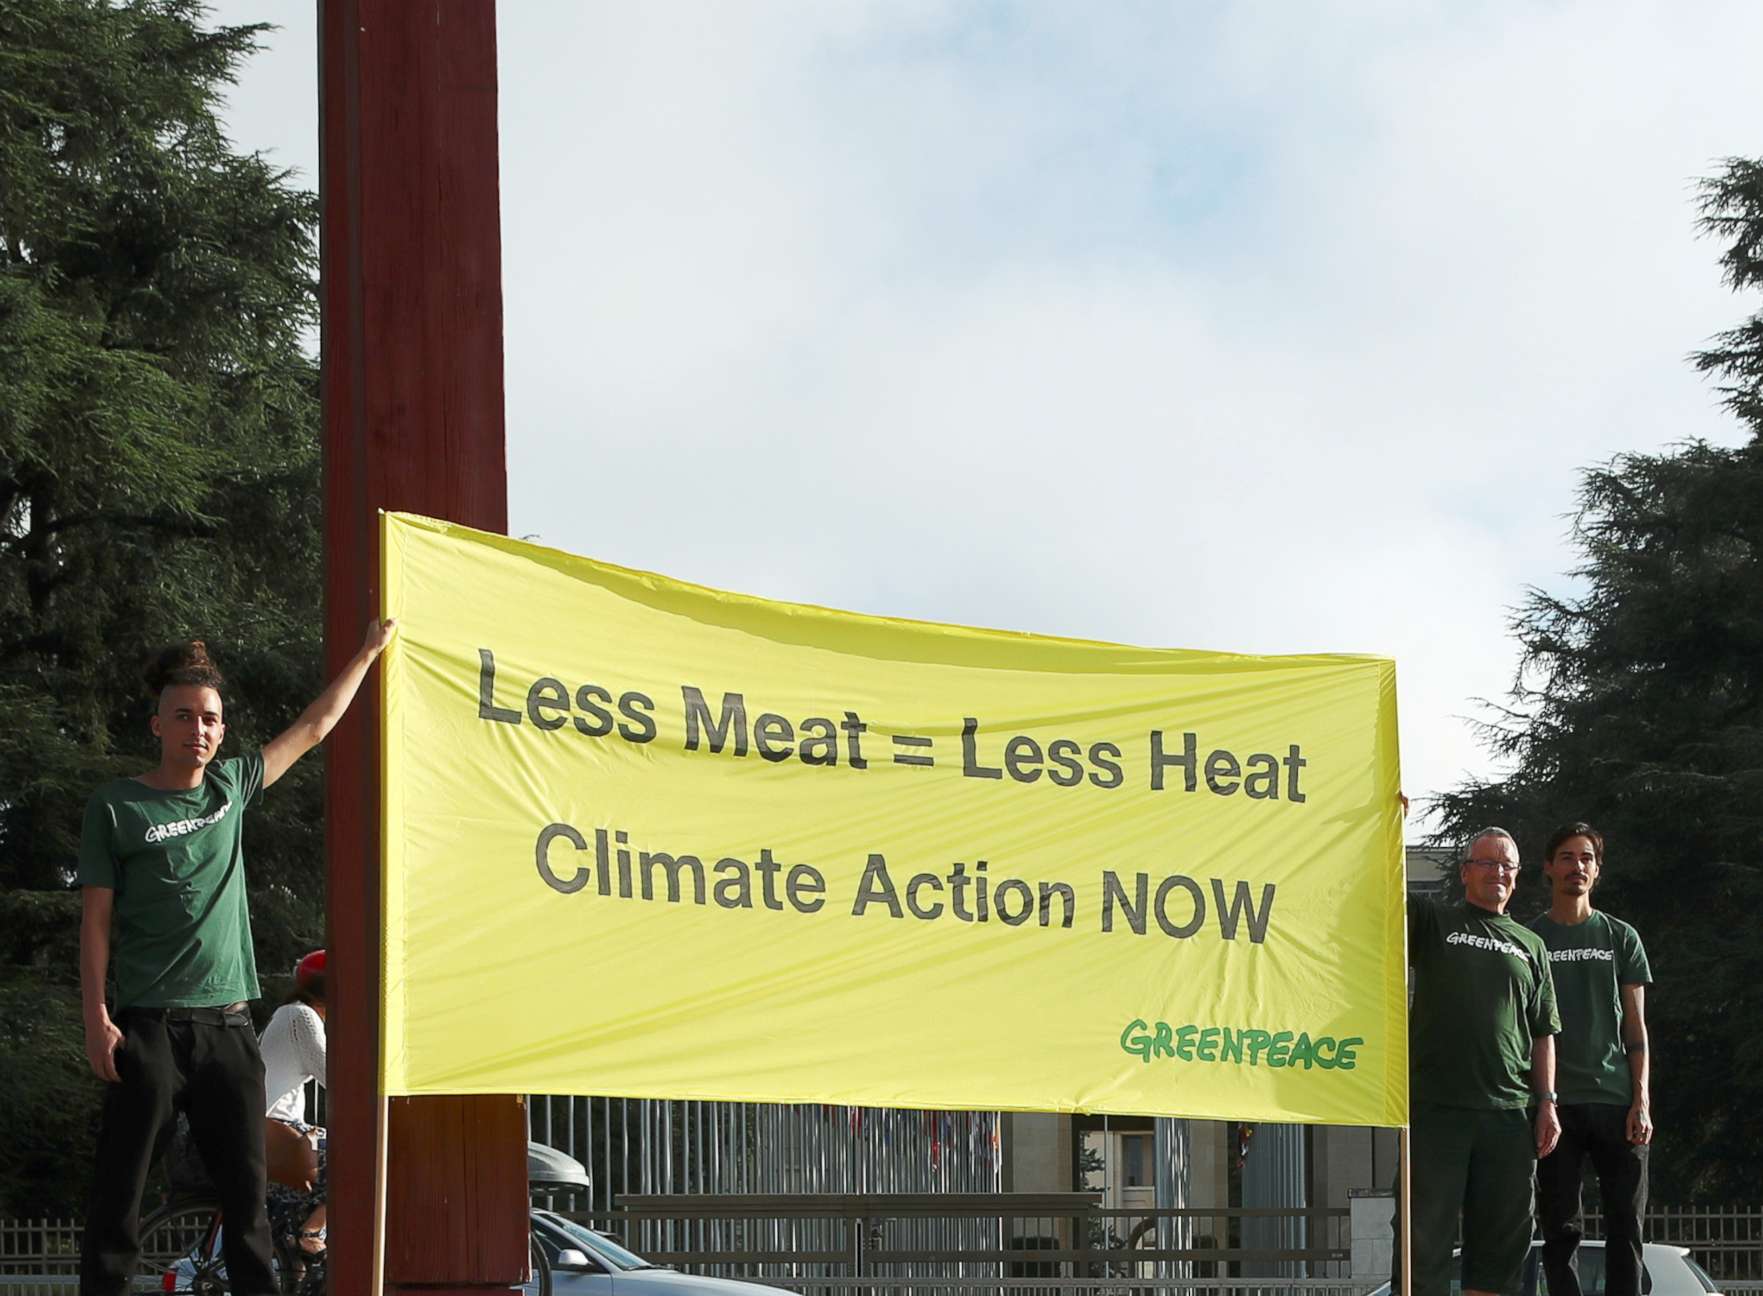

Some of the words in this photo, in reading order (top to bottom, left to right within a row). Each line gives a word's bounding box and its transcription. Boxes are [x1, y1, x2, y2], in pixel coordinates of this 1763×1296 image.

[479, 649, 656, 743] Less
[681, 686, 867, 769] Meat
[892, 735, 934, 766] =
[961, 718, 1123, 789] Less
[1151, 730, 1306, 803] Heat
[536, 823, 826, 913] Climate
[852, 854, 1074, 928] Action
[1102, 871, 1275, 944] NOW
[1547, 948, 1614, 962] REENPEACE
[1121, 1019, 1364, 1070] GREENPEACE
